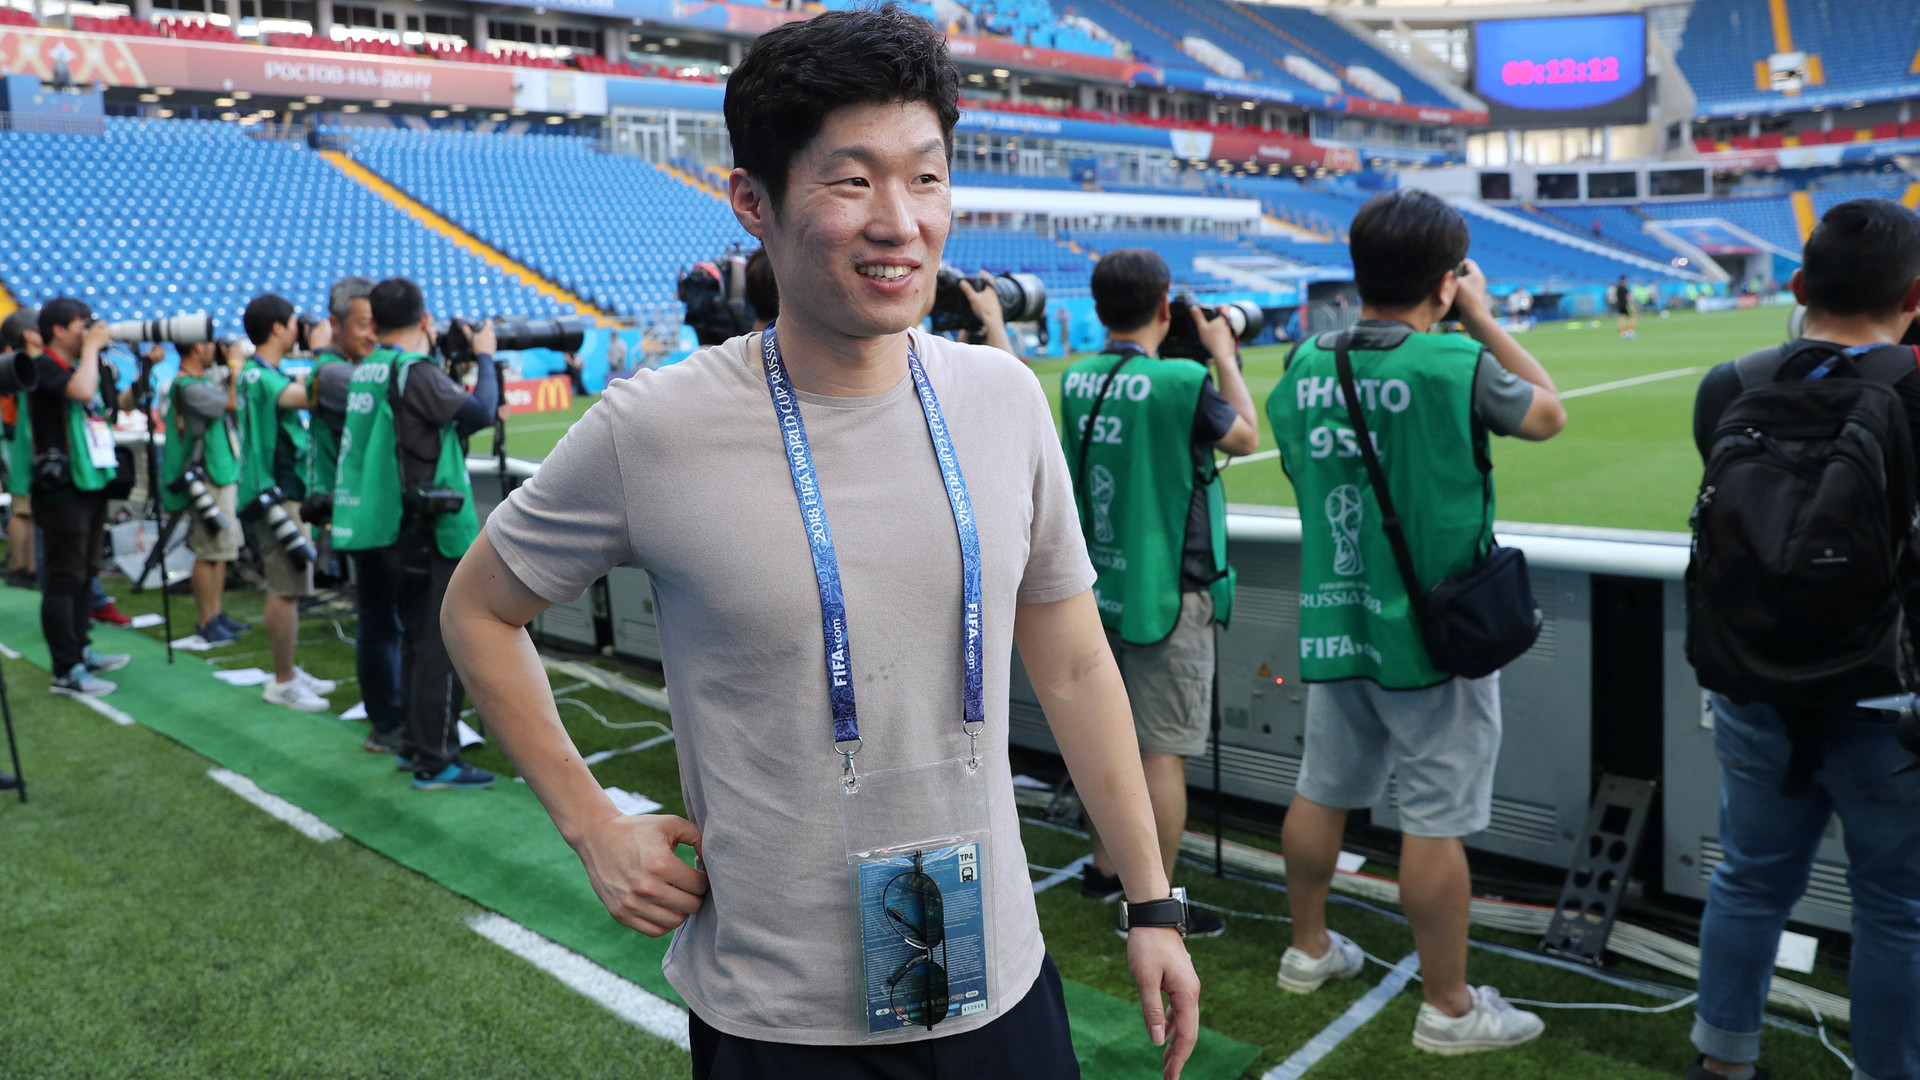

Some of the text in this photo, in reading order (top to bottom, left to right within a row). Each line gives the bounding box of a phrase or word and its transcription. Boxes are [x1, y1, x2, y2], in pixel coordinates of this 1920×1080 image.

[352, 362, 390, 384] HOTO
[1064, 372, 1151, 402] PHOTO
[1296, 376, 1411, 413] PHOTO
[765, 336, 827, 544] 2018 FIFA WORLD CUP RUSSIA
[910, 356, 971, 526] FIFA WORLD CUP RUSSIA
[1299, 591, 1361, 609] RUSSIA
[831, 618, 847, 687] FIFA.com
[968, 603, 978, 669] FIFA.com
[960, 852, 973, 861] TP4
